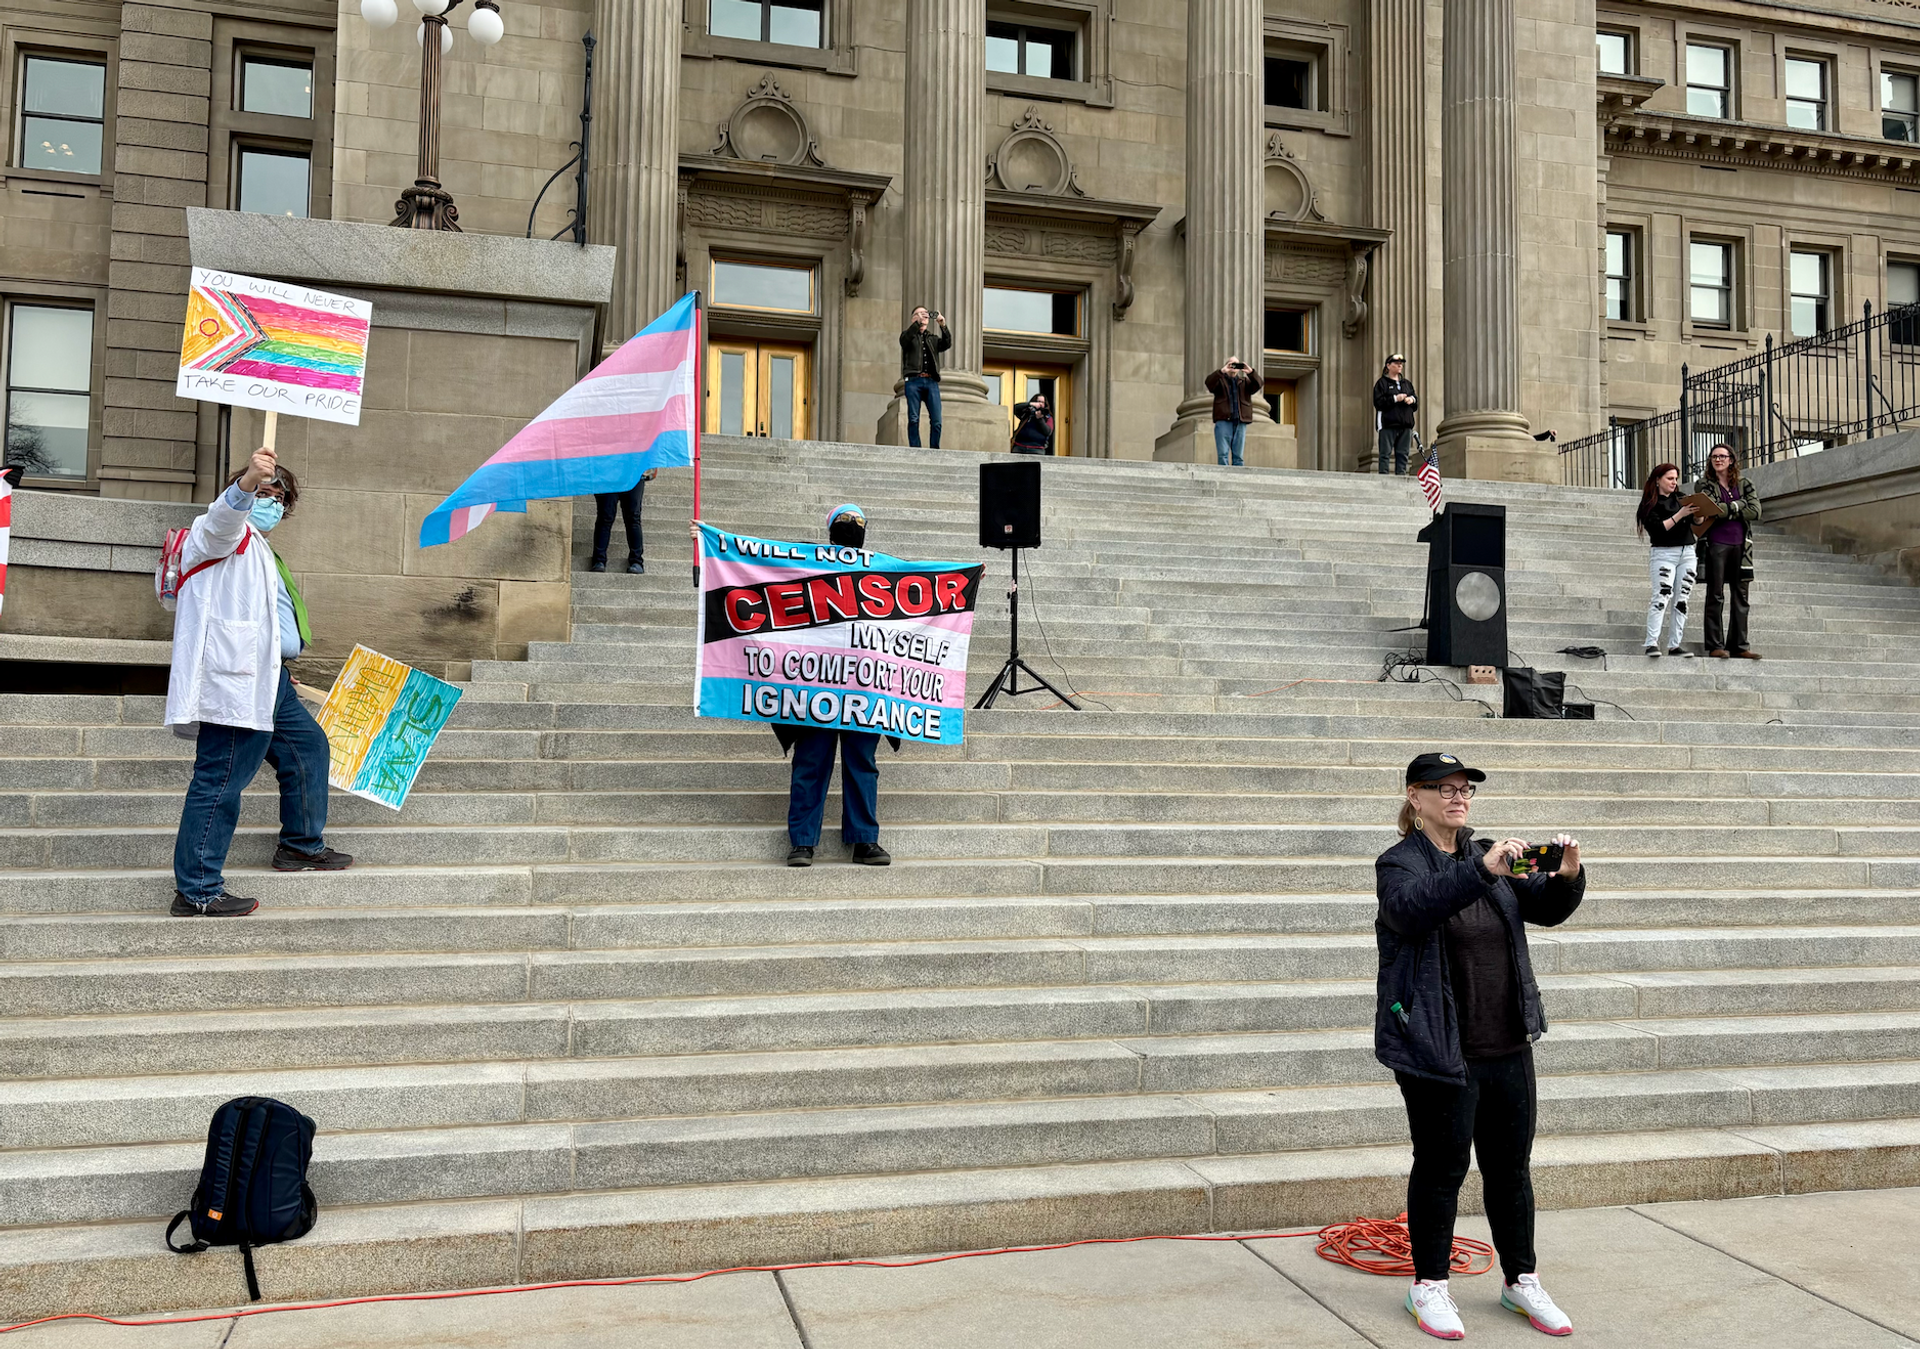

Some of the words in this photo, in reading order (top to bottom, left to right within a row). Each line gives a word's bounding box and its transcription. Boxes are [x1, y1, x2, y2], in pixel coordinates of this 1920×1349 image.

[200, 271, 233, 287] YOU
[249, 281, 293, 300] WILL
[303, 292, 360, 317] NEVER
[184, 374, 236, 392] TAKE
[247, 383, 297, 404] OUR
[305, 393, 358, 414] PRIDE
[718, 534, 728, 553] I
[734, 537, 807, 560] WILL
[816, 546, 875, 567] NOT
[724, 572, 970, 633] CENSOR
[851, 622, 950, 665] MYSELF
[744, 646, 775, 677] TO
[783, 650, 897, 690] COMFORT
[901, 665, 945, 702] YOUR
[742, 683, 942, 740] IGNORANCE
[371, 690, 443, 792] SLAVA
